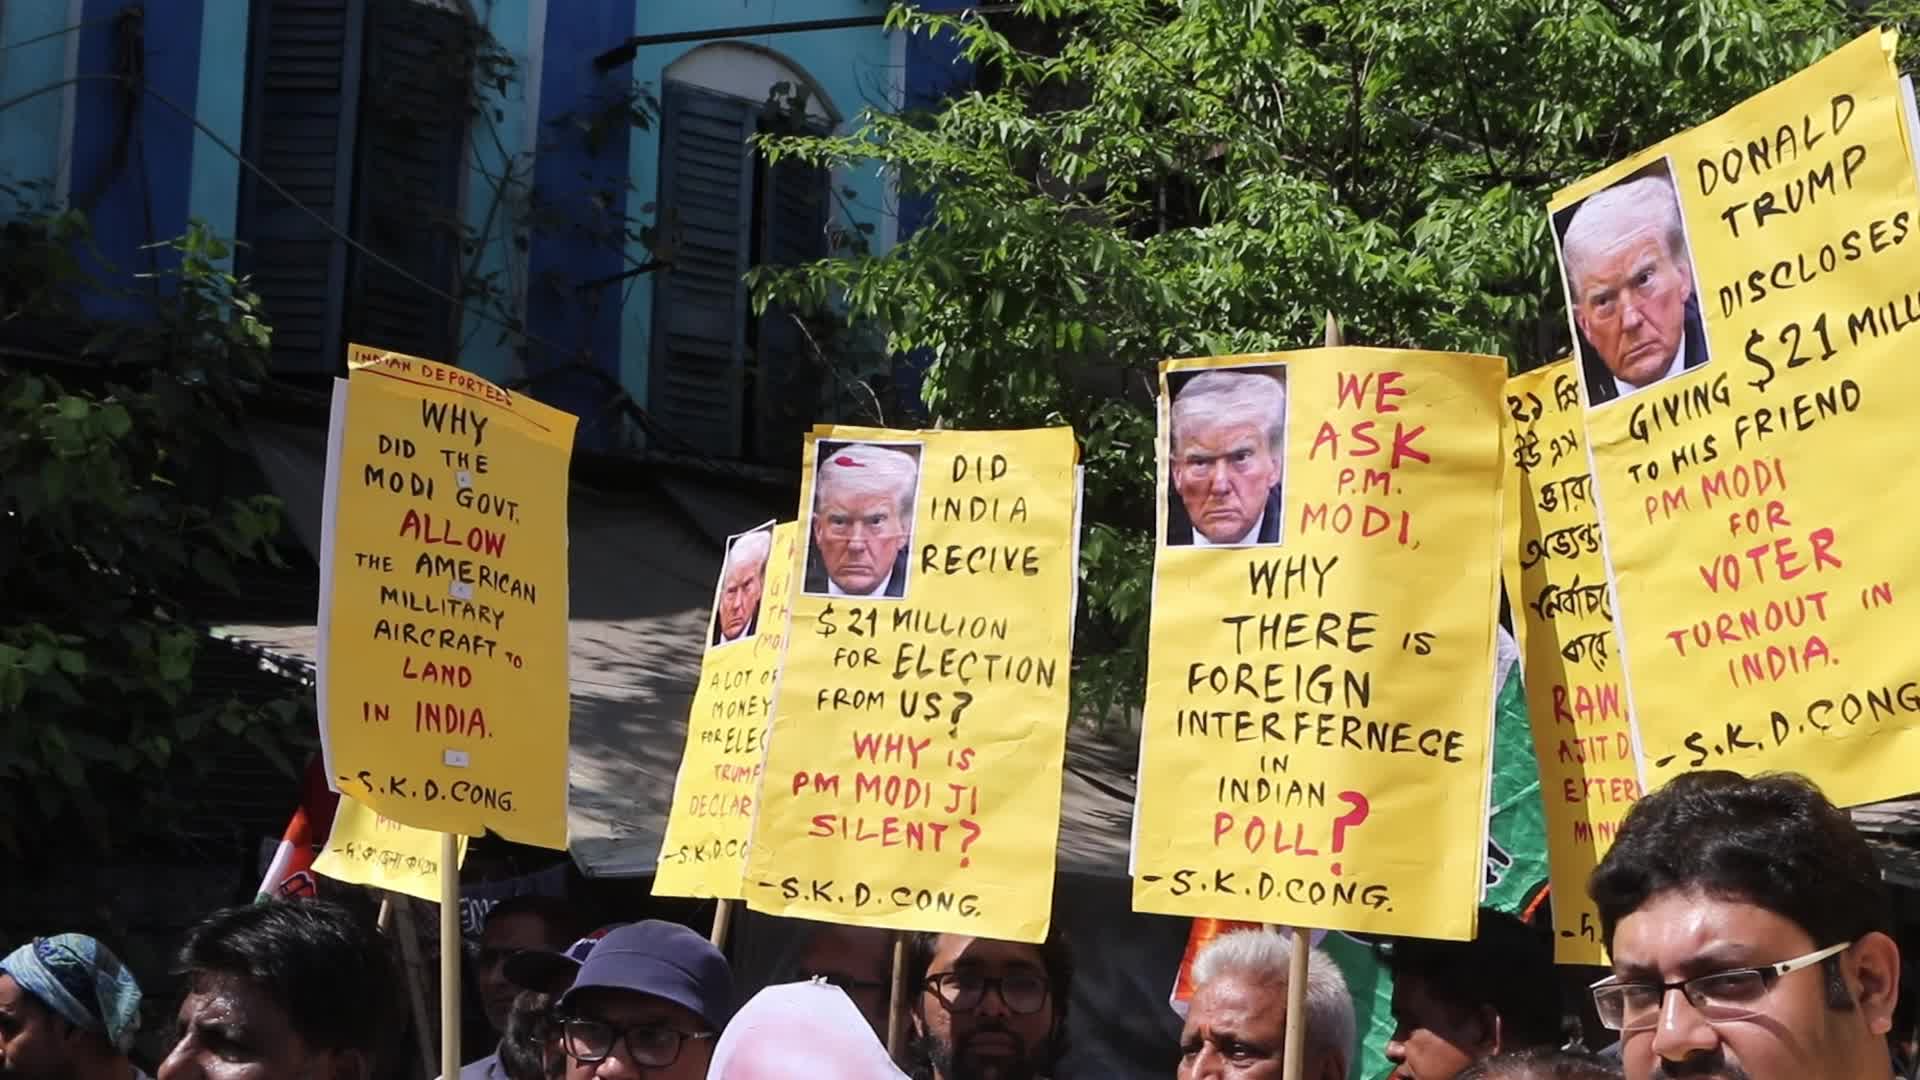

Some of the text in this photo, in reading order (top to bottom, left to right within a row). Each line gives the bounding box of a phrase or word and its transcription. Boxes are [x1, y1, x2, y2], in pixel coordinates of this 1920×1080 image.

[1698, 94, 1855, 196] DONALD
[1721, 144, 1867, 238] TRUMP
[1719, 211, 1909, 318] DISCLOSES
[354, 351, 412, 372] INDIAN
[1744, 290, 1920, 393] $21 MILL
[1336, 371, 1408, 414] WE
[1628, 371, 1731, 443] GIVING
[422, 398, 488, 447] WHY
[1309, 420, 1431, 470] ASK
[1627, 379, 1861, 485] TO HIS FRIEND
[378, 434, 489, 474] DID THE
[953, 454, 1008, 483] DID
[364, 463, 520, 524] MODI GOVT.
[1338, 468, 1403, 497] P.M.
[1645, 457, 1787, 526] PM MODI
[930, 496, 1028, 524] INDIA
[1729, 500, 1792, 538] FOR
[399, 509, 507, 559] ALLOW
[355, 552, 536, 605] THE AMERICAN
[921, 544, 1041, 577] RECIVE
[1249, 555, 1339, 600] WHY
[1699, 527, 1843, 595] VOTER
[380, 585, 505, 630] MILLITARY
[893, 606, 1008, 641] MILLION
[1665, 581, 1894, 657] TURNOUT IN
[374, 619, 523, 669] AIRCRAFT TO
[1222, 611, 1437, 655] THERE IS
[402, 657, 472, 688] LAND
[834, 642, 1058, 689] FOR ELECTION
[1187, 662, 1371, 709] FOREIGN
[1729, 635, 1840, 689] INDIA.
[363, 701, 493, 739] IN INDIA.
[711, 695, 773, 720] MONEY
[816, 688, 974, 739] FROM US?
[852, 731, 976, 771] WHY IS
[1176, 710, 1466, 763] INTERFERNECE
[1557, 734, 1608, 765] AJIT
[1260, 754, 1289, 774] IN
[792, 771, 978, 815] PM MODI JI
[1217, 776, 1326, 808] INDIAN
[807, 813, 982, 870] SILENT?
